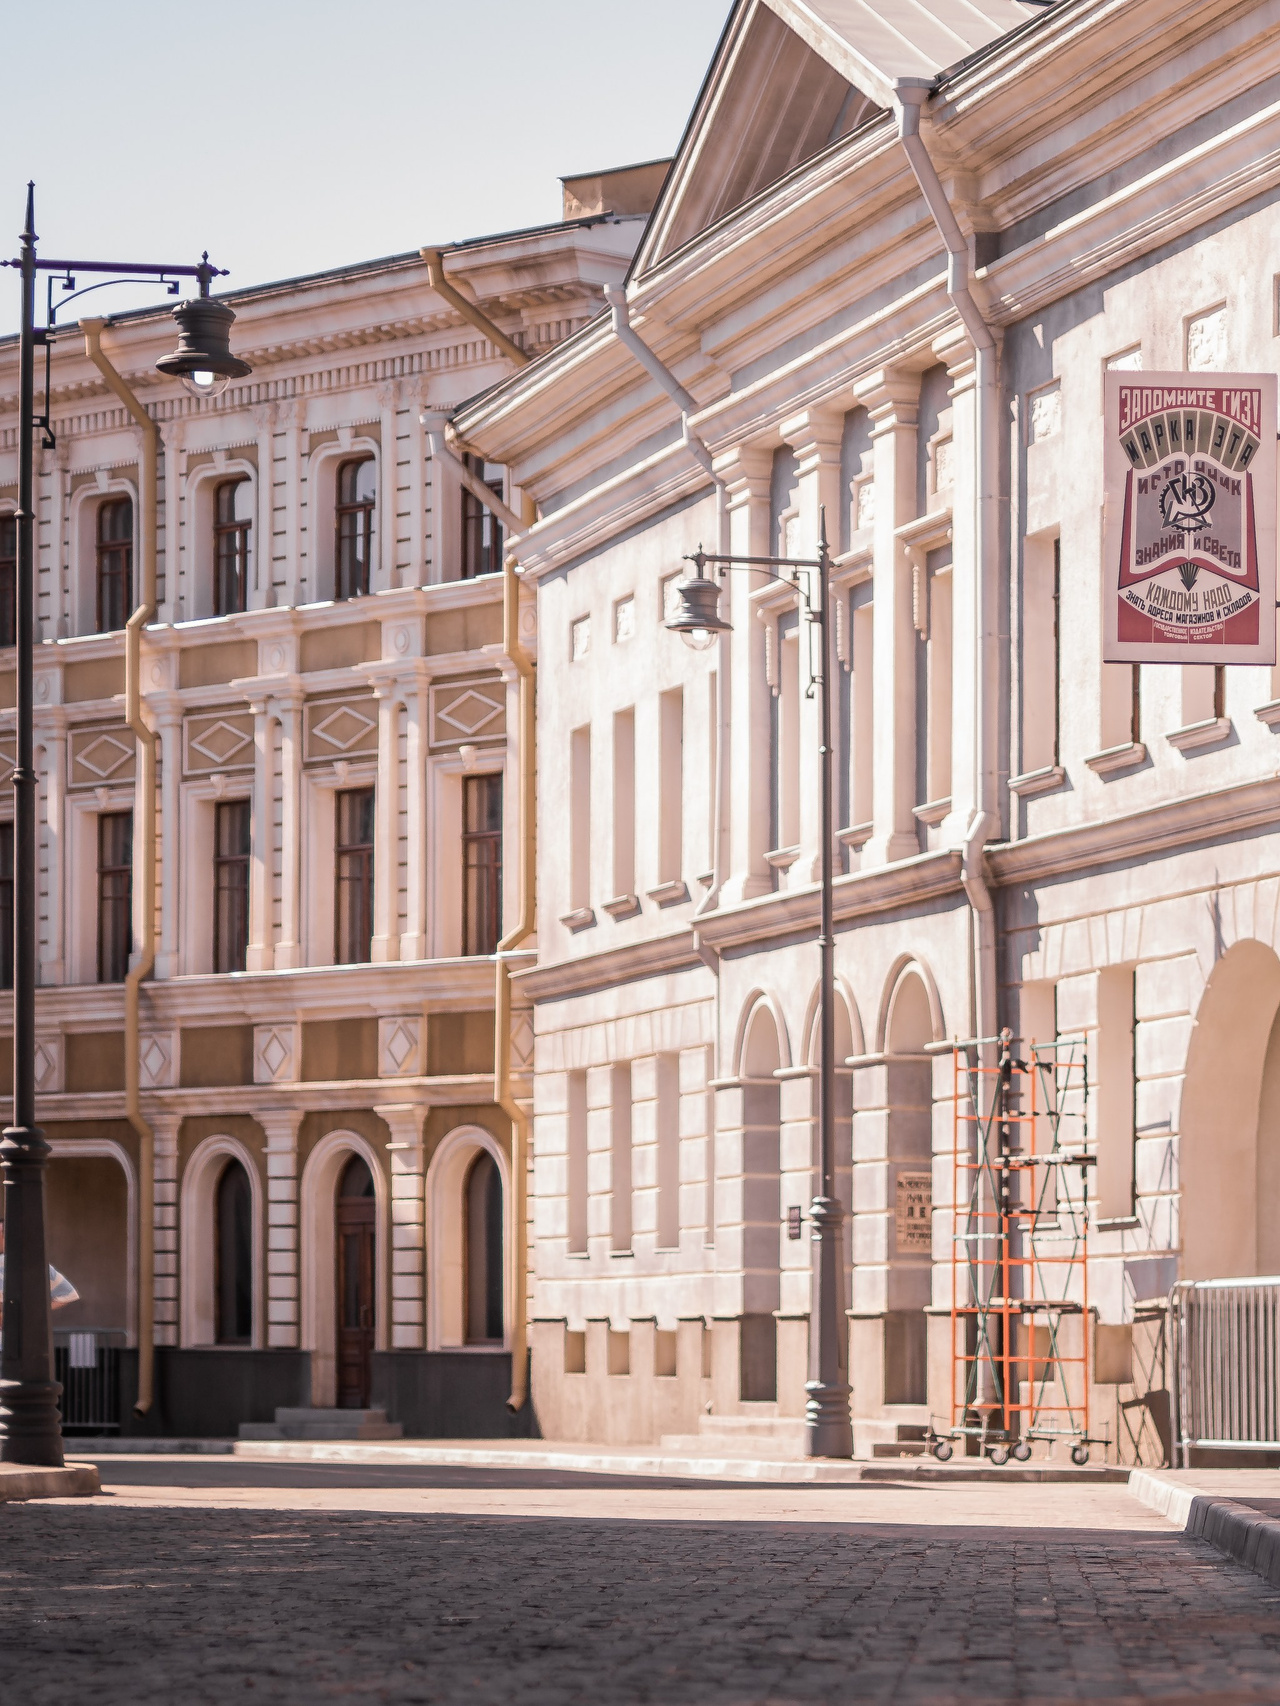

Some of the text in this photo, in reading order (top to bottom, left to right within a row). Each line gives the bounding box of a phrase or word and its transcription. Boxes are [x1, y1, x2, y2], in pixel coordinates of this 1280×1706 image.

[1121, 389, 1260, 434] ЗАПОМНИТЕ ГИЗ!
[1126, 419, 1254, 466] МАРКА ЭТА
[1135, 533, 1185, 566] ЗНАНИЯ
[1203, 536, 1242, 569] СВЕТА
[1125, 589, 1252, 624] ЗНАТЬ АДРЕСА МАГАЗИНОВ И СКЛАДОВ
[1146, 581, 1232, 612] КАЖДОМУ НАДО
[1190, 623, 1224, 634] ИЗДАТЕЛЬСТВО
